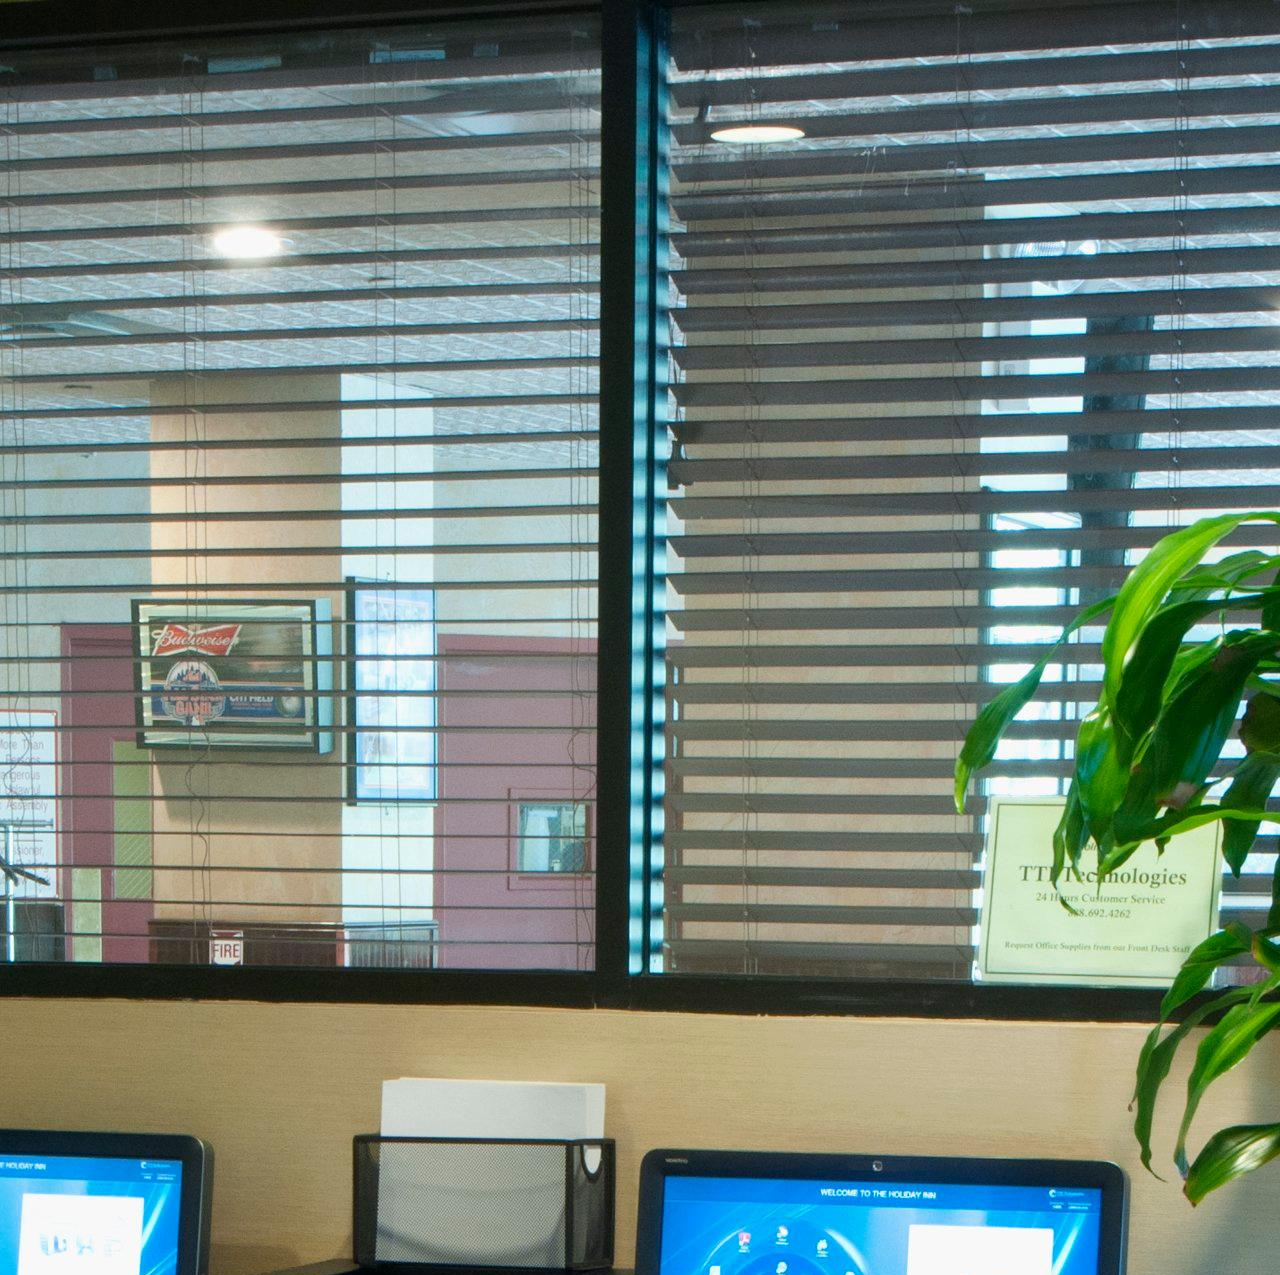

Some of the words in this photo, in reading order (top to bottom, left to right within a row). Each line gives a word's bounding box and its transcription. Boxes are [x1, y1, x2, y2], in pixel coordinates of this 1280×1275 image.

[152, 629, 240, 648] Budweiser
[1036, 892, 1048, 902] 24
[1081, 893, 1129, 904] Customer
[1130, 895, 1167, 906] Service
[1068, 908, 1132, 919] 8.692.4262
[211, 943, 240, 959] FIRE
[1005, 941, 1034, 951] Request
[1035, 941, 1057, 950] Office
[1060, 942, 1091, 953] Supplies
[6, 1162, 34, 1170] HOLIDAY
[820, 1188, 858, 1197] WELCOME
[860, 1189, 871, 1197] TO
[873, 1190, 887, 1198] THE
[888, 1190, 922, 1199] HOLIDAY
[922, 1191, 937, 1199] INN
